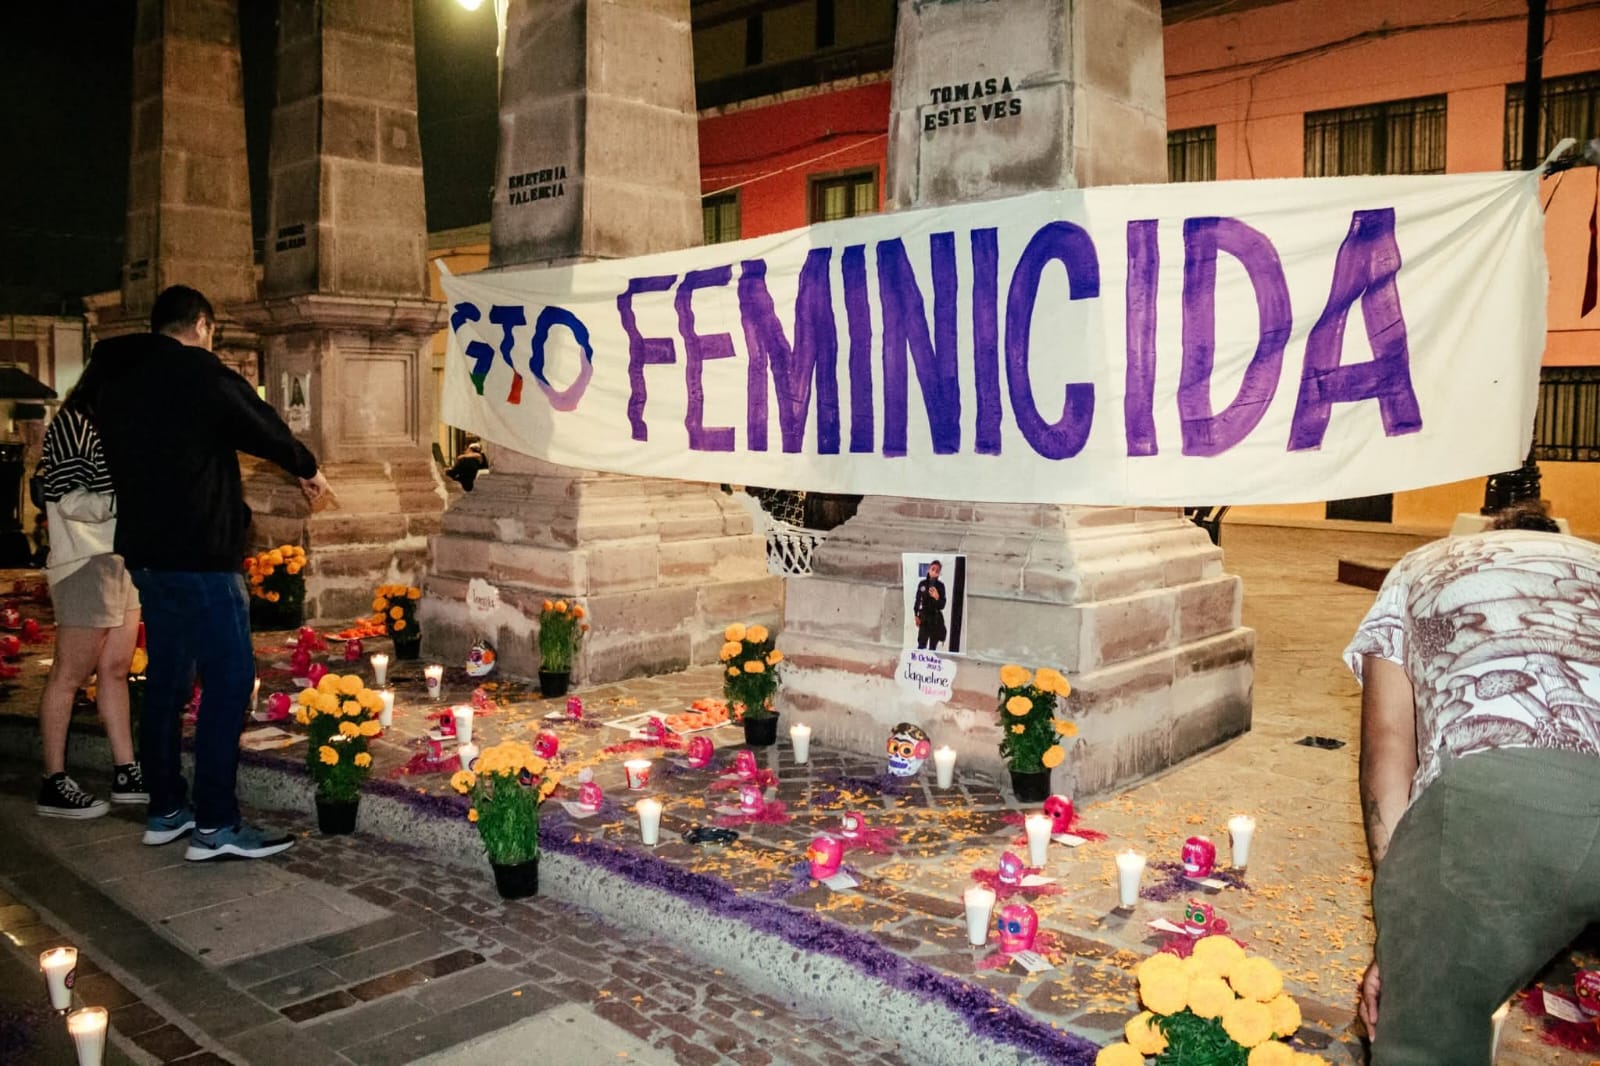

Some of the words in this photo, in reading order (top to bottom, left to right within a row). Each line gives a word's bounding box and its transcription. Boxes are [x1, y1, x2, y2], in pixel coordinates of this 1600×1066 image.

[930, 76, 1013, 105] TOMASA
[924, 98, 1022, 131] ESTEVES
[508, 183, 565, 206] VALENCIA
[450, 302, 594, 412] GTO
[617, 207, 1423, 460] FEMINICIDA
[904, 662, 949, 690] Jaqueline
